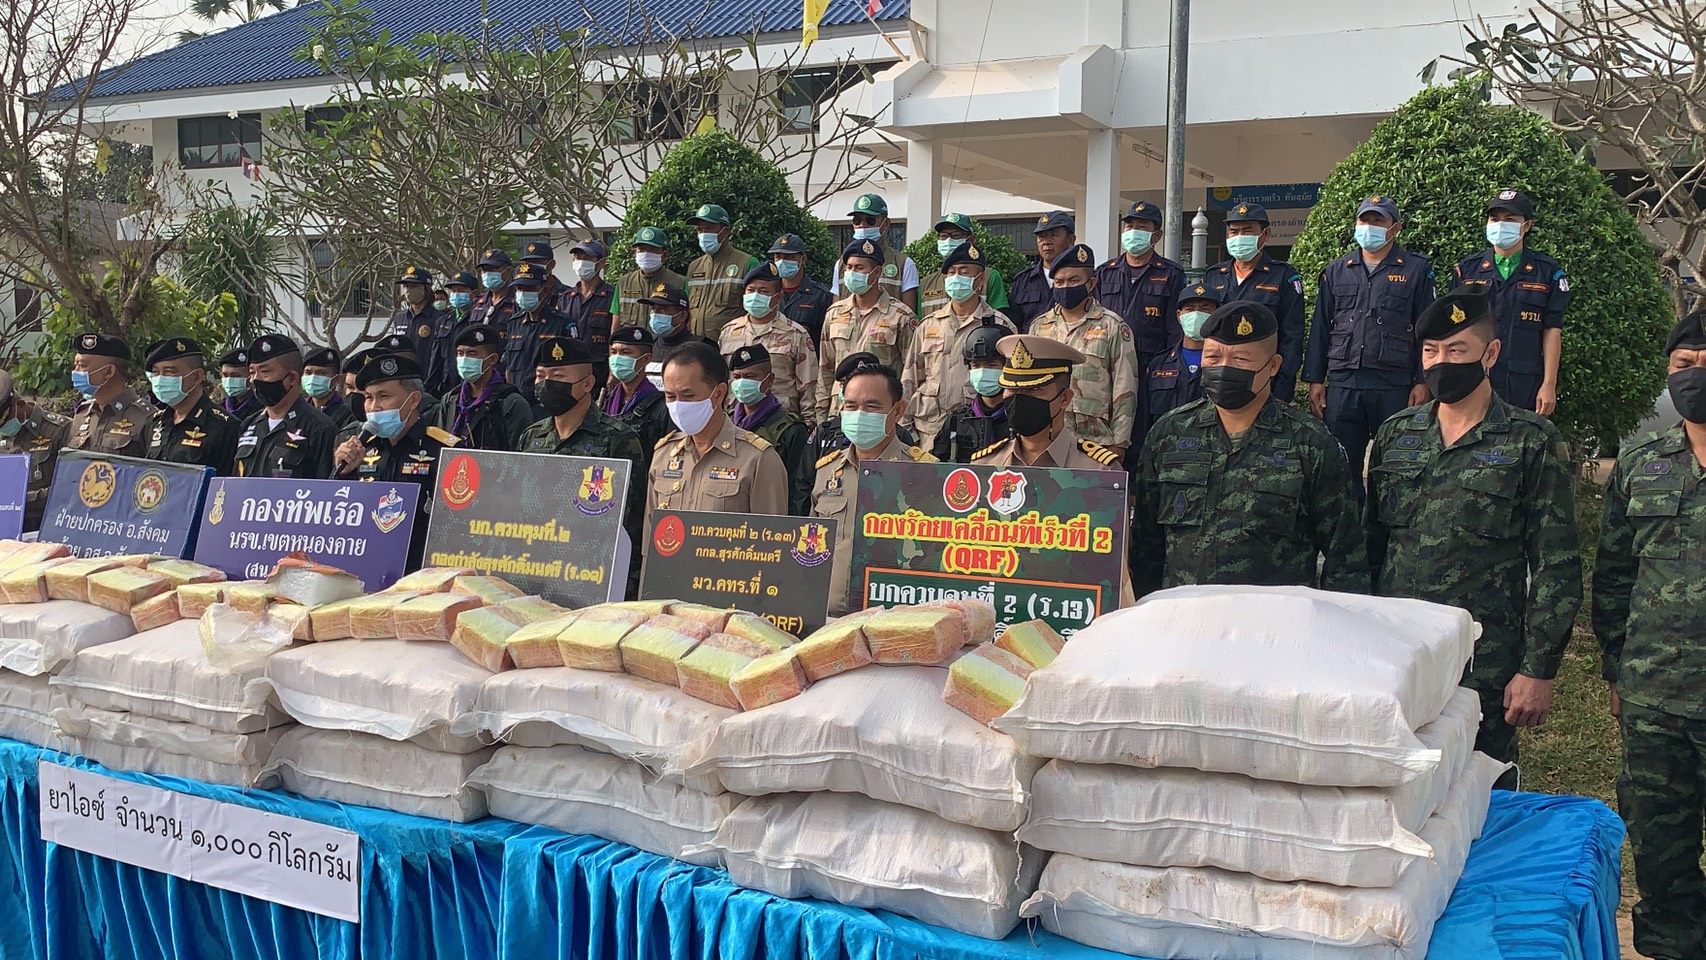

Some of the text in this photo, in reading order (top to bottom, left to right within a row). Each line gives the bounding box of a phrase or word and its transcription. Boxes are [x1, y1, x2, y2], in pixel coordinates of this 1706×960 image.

[1520, 311, 1542, 323] ชรบ.
[240, 486, 366, 527] กองทัพเรือ
[54, 508, 170, 544] ฝ่ายปกครอง อ.สังคม
[691, 521, 796, 543] บก.ควบคุมที่ ๒ (ร.๑๓)
[864, 509, 1111, 551] กองร้อยเคลื่อนที่เร็วที่ 2
[229, 531, 368, 556] นรข.เขตหนองคาย
[695, 544, 782, 563] กกล.สุรศักดิ์มนตรี
[431, 550, 561, 577] กองกำลังสุรศักดิ์มนตรี
[943, 544, 1018, 576] (QRF)
[692, 570, 779, 597] มว.คทร.ที่ ๑
[869, 581, 1095, 625] บกควบคมที่ 2 (ร.13)
[760, 612, 804, 635] RF)
[49, 781, 352, 883] ยาไอซ์ จำนวน ๑,๐๐๐ กิโลกรัม
